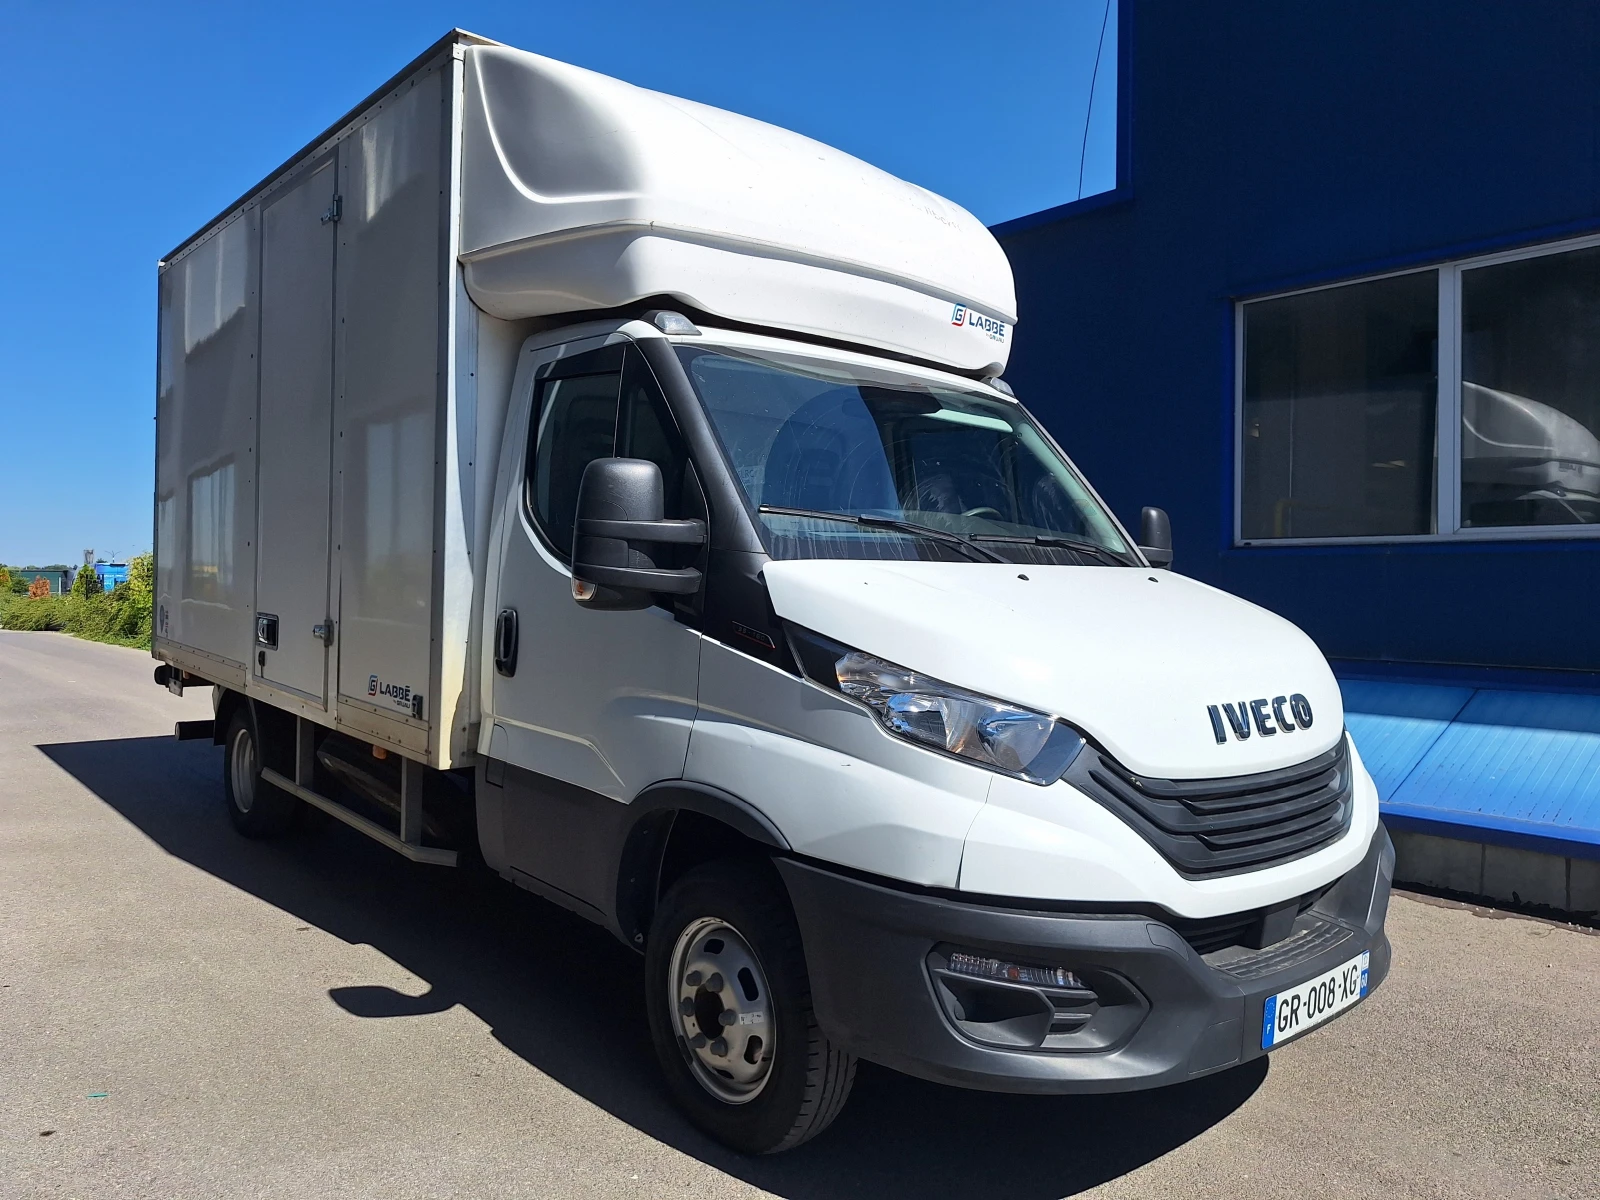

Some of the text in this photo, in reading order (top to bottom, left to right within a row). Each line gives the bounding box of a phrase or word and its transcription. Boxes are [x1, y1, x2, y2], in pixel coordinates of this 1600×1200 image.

[1206, 693, 1313, 745] IVECO
[1266, 1023, 1272, 1035] F
[1277, 964, 1358, 1033] GR-008-XG
